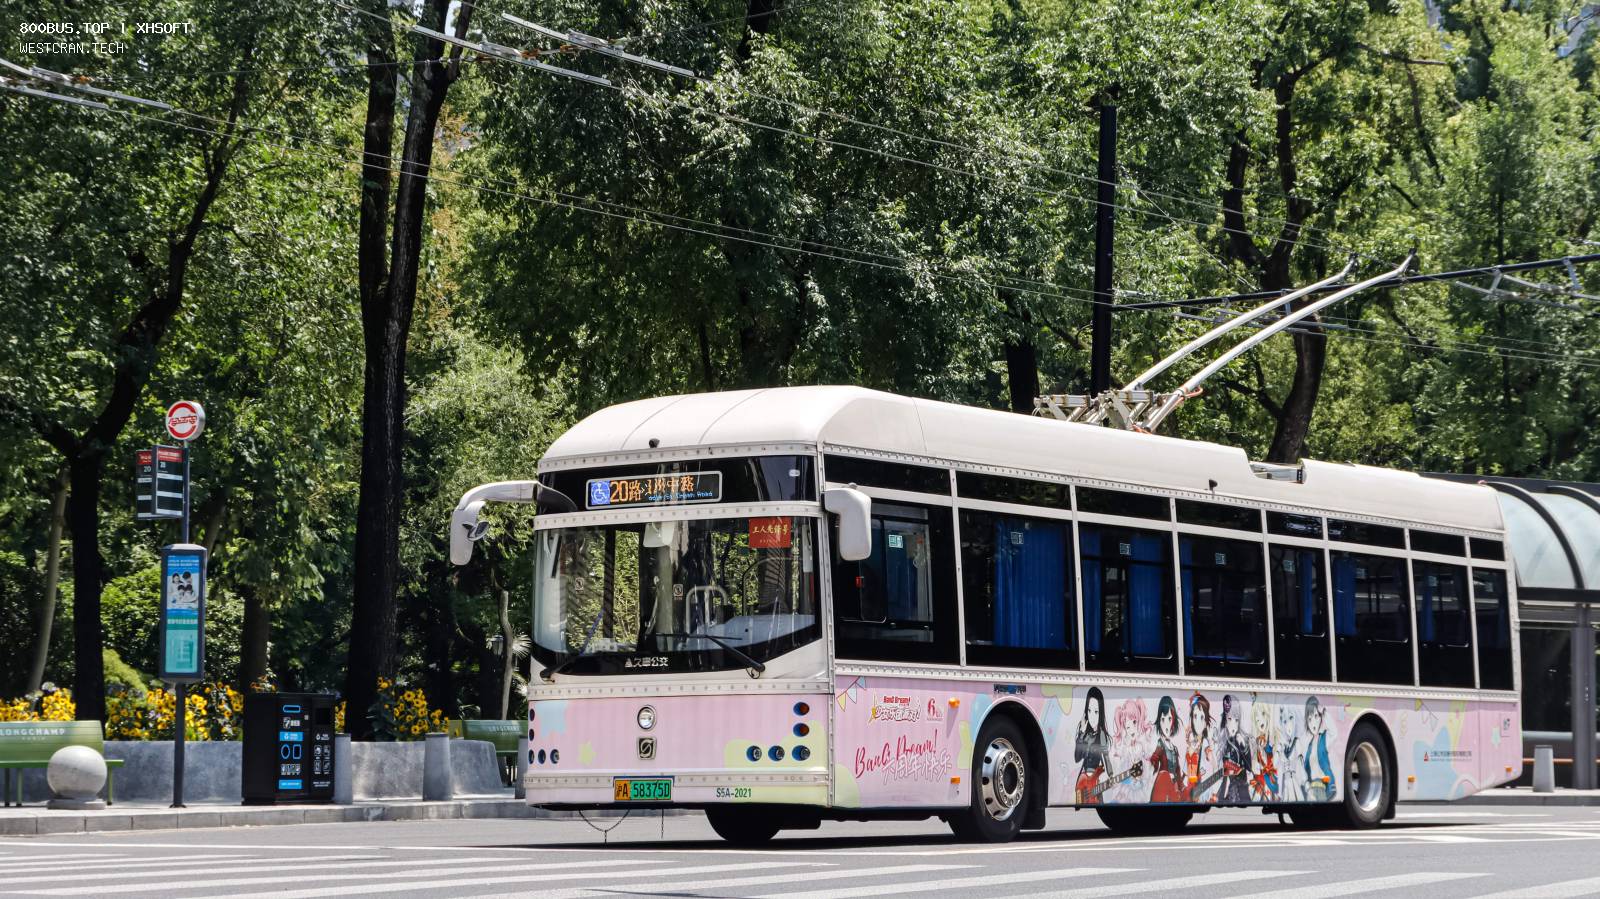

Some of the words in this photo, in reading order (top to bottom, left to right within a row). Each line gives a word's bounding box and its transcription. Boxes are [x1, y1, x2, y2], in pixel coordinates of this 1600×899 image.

[143, 465, 152, 473] 20
[0, 727, 65, 736] LONGCHAMP
[896, 728, 938, 761] Dream!
[633, 783, 671, 797] 58375D
[716, 787, 752, 798] S5A-2021
